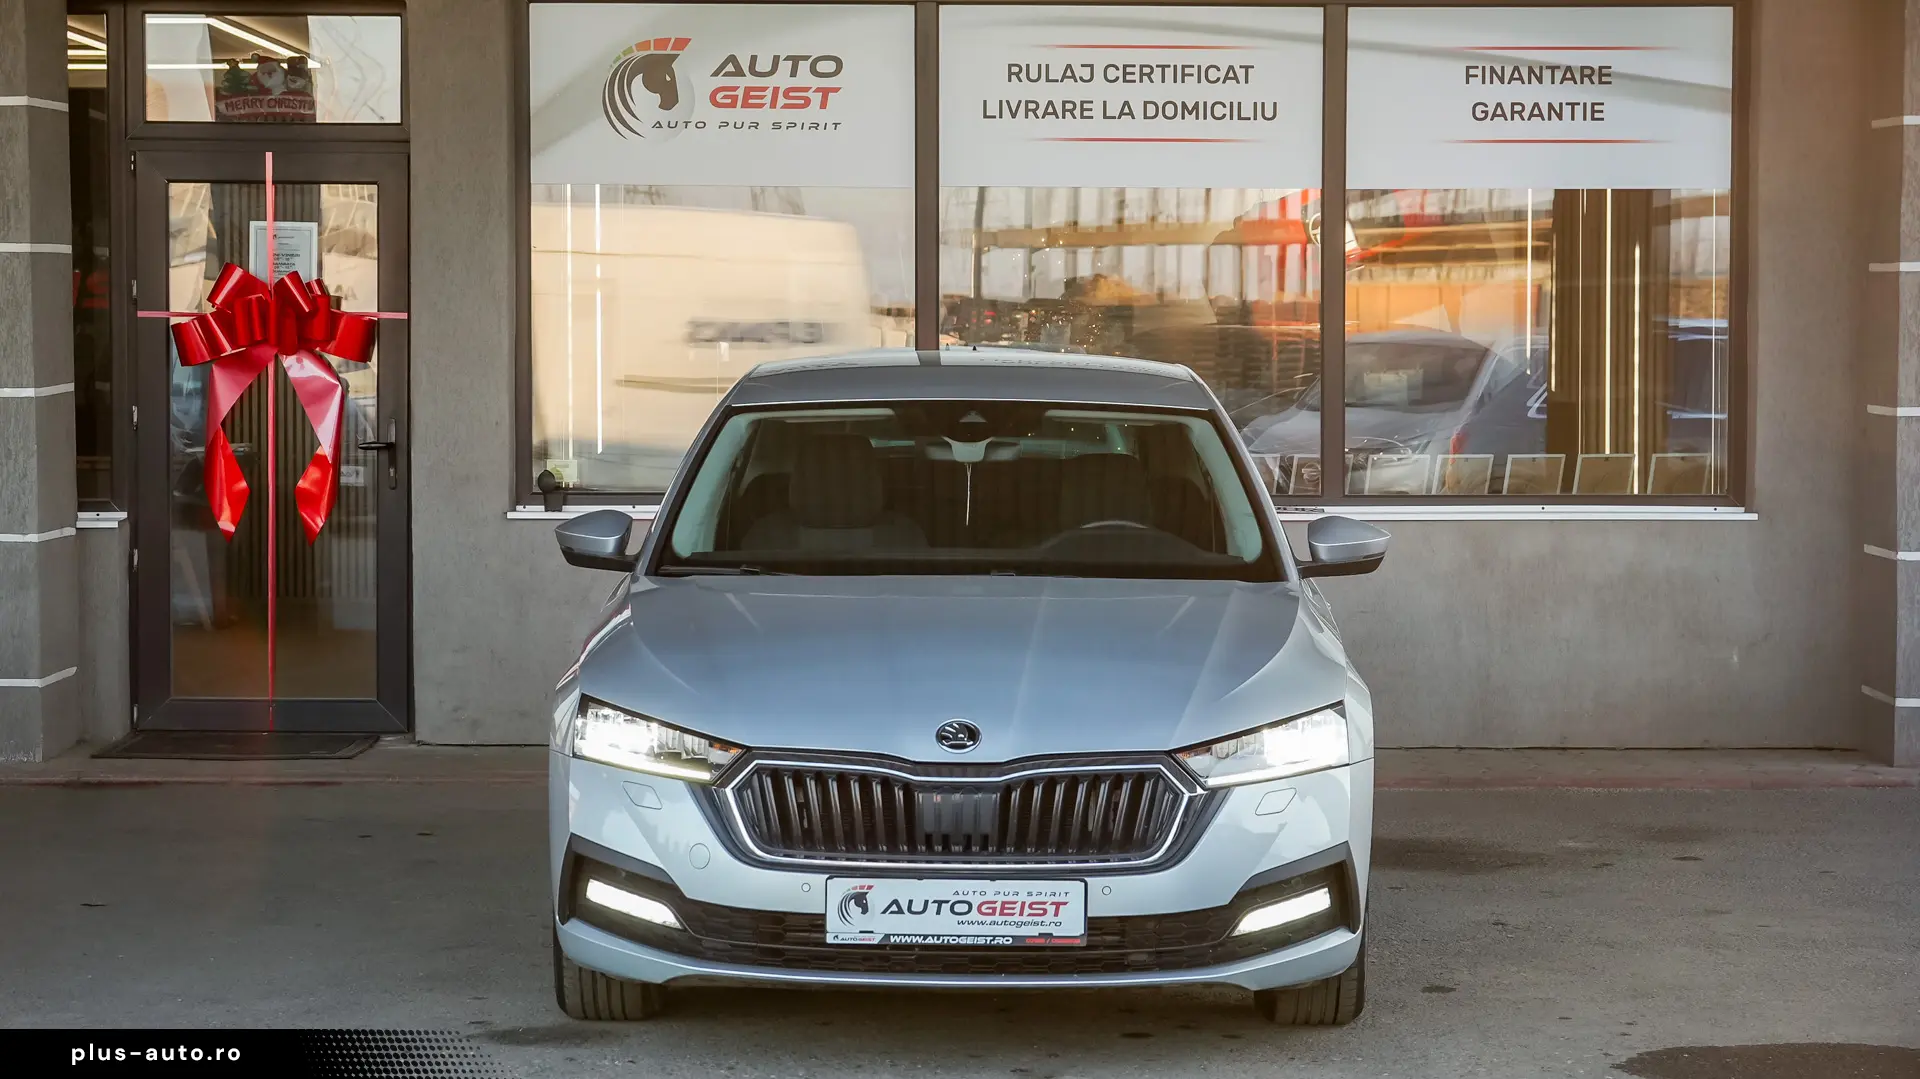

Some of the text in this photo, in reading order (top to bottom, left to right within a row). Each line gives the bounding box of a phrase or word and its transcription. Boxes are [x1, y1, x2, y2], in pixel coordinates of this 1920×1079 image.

[710, 54, 843, 78] AUTO
[1007, 63, 1254, 84] RULAJ CERTIFICAT
[1465, 65, 1612, 85] FINANTARE
[224, 97, 265, 112] MERRY
[709, 86, 842, 109] GEIST
[982, 99, 1278, 121] LIVRARE LA DOMICILIU
[1471, 102, 1605, 121] GARANTIE
[651, 120, 842, 131] AUTO PUR SPIRIT
[957, 919, 1062, 928] www.autogeist.ro
[890, 935, 1013, 945] WWW.AUTOGEIST.RO
